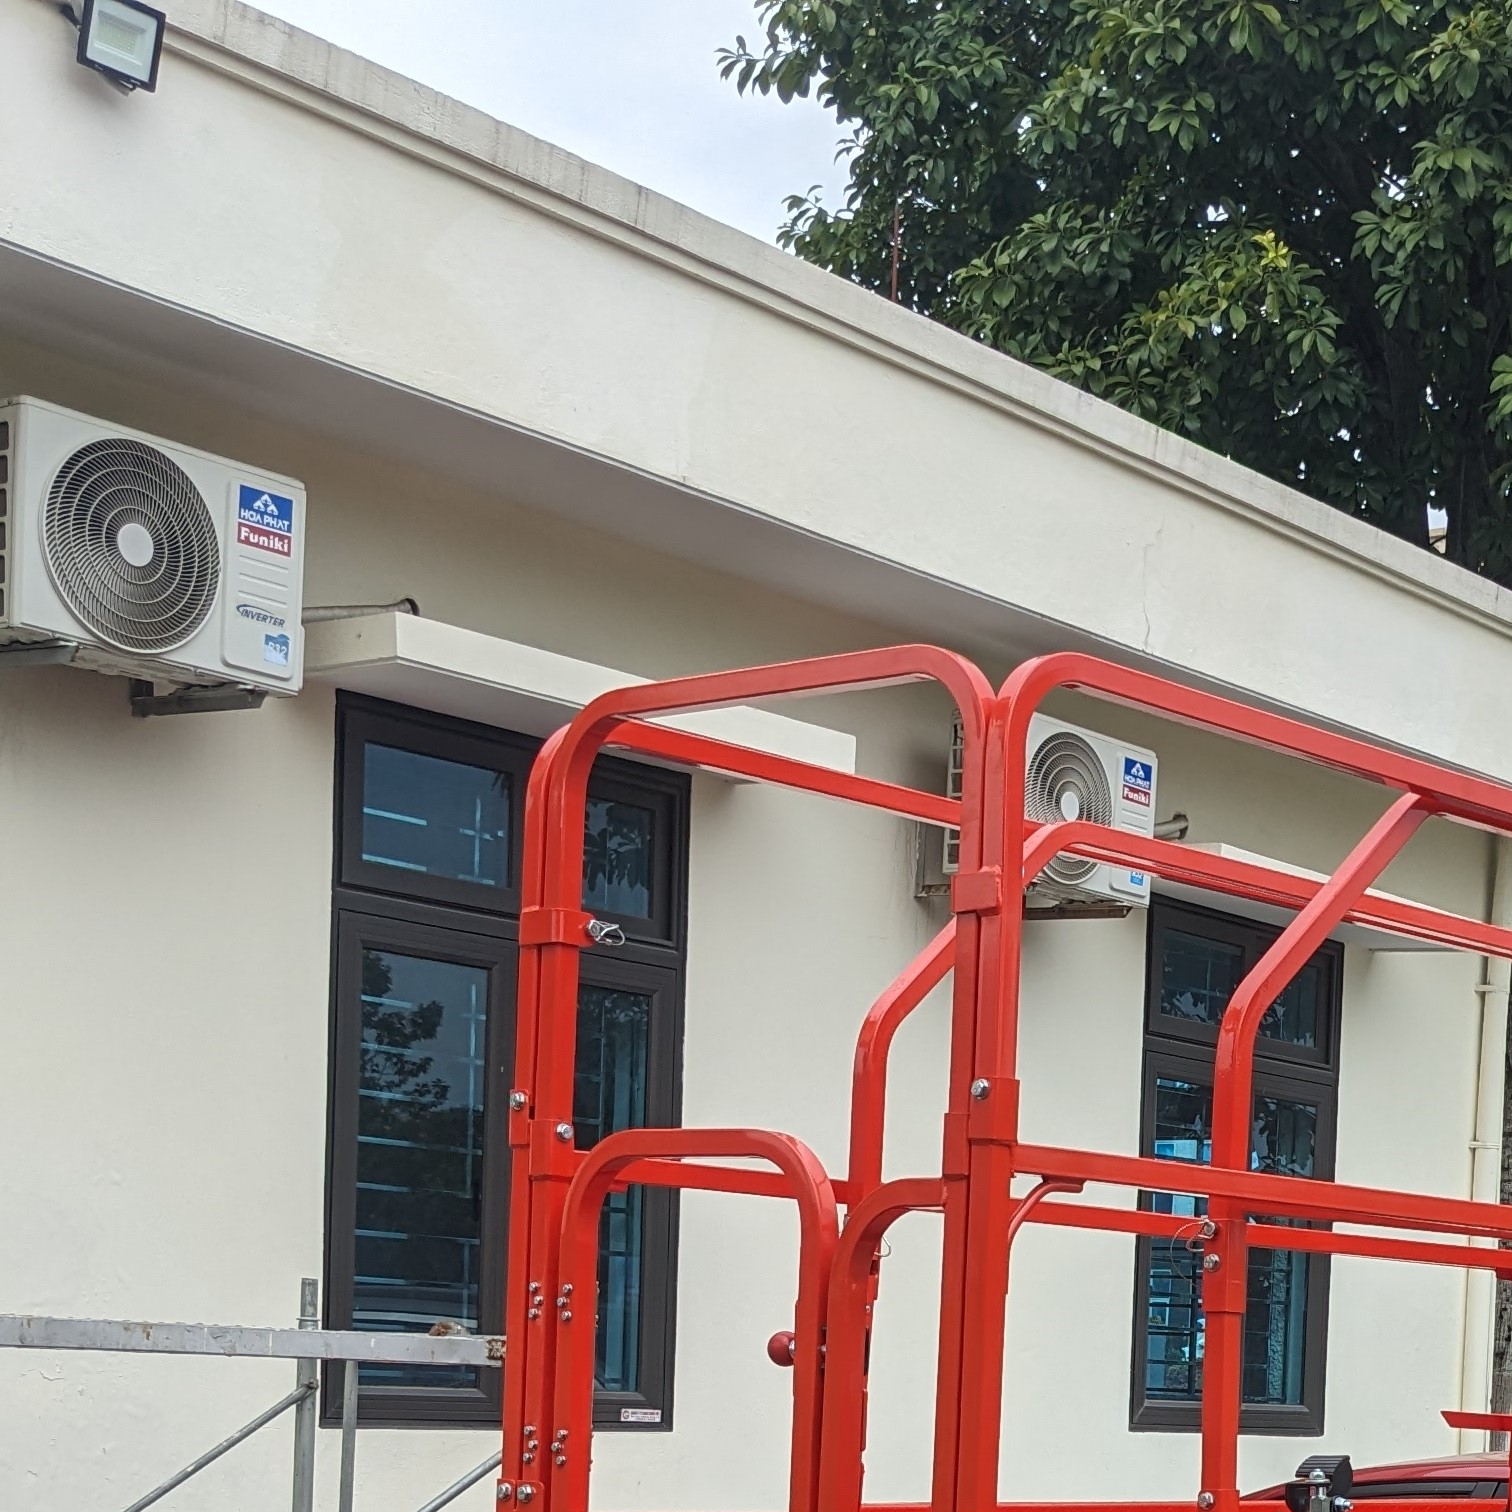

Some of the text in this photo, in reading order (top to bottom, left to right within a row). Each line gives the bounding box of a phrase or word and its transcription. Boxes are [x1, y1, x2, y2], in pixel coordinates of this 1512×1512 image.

[240, 526, 289, 553] Funiki
[240, 607, 286, 629] INVERTER
[1123, 786, 1149, 805] Funiki
